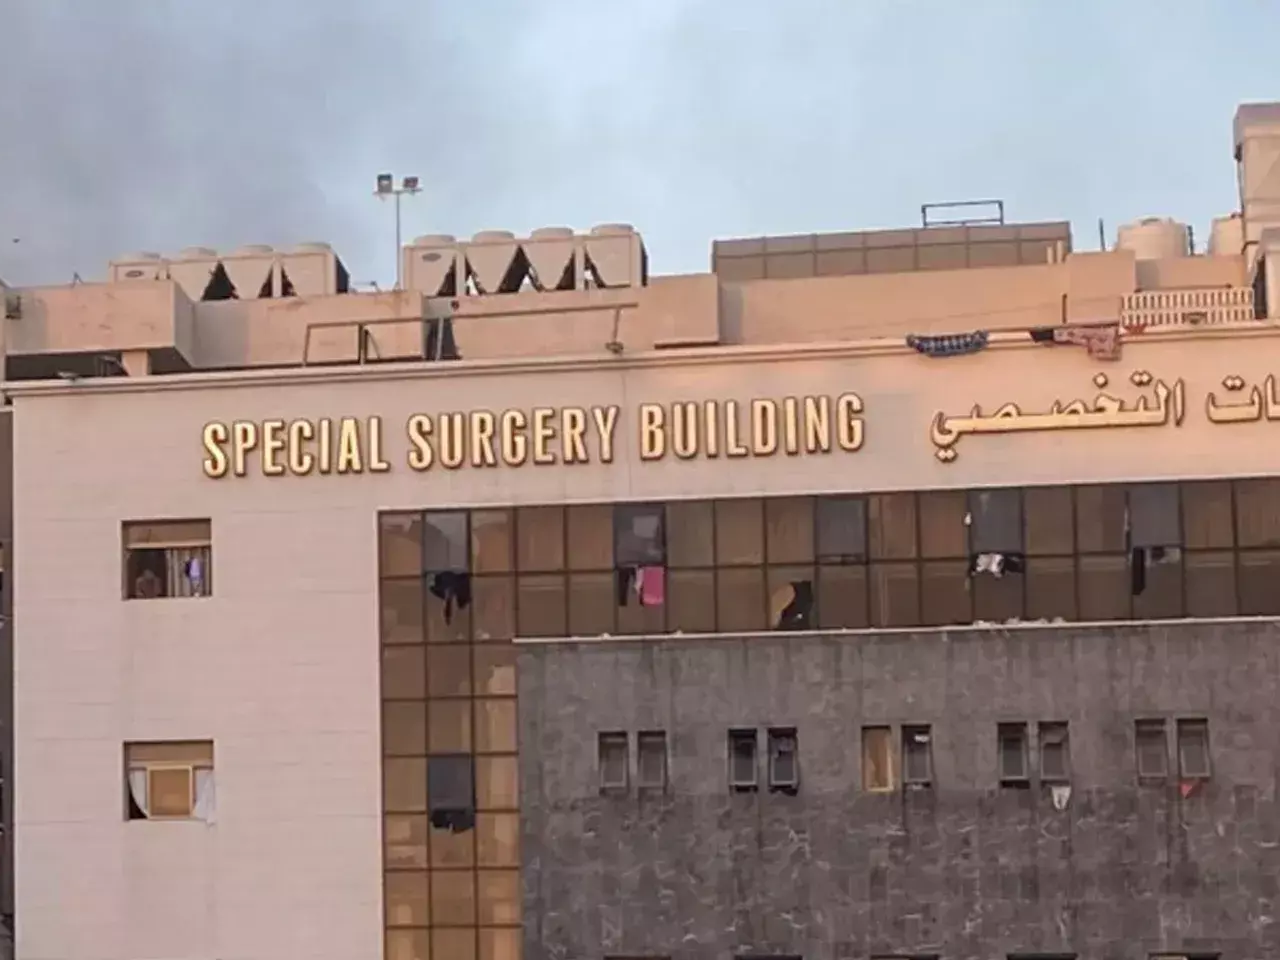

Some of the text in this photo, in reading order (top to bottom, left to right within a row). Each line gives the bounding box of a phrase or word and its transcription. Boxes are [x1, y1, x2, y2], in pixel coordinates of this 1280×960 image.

[202, 392, 866, 478] SPECIAL SURGERY BUILDING
[929, 370, 1186, 463] التخصصي
